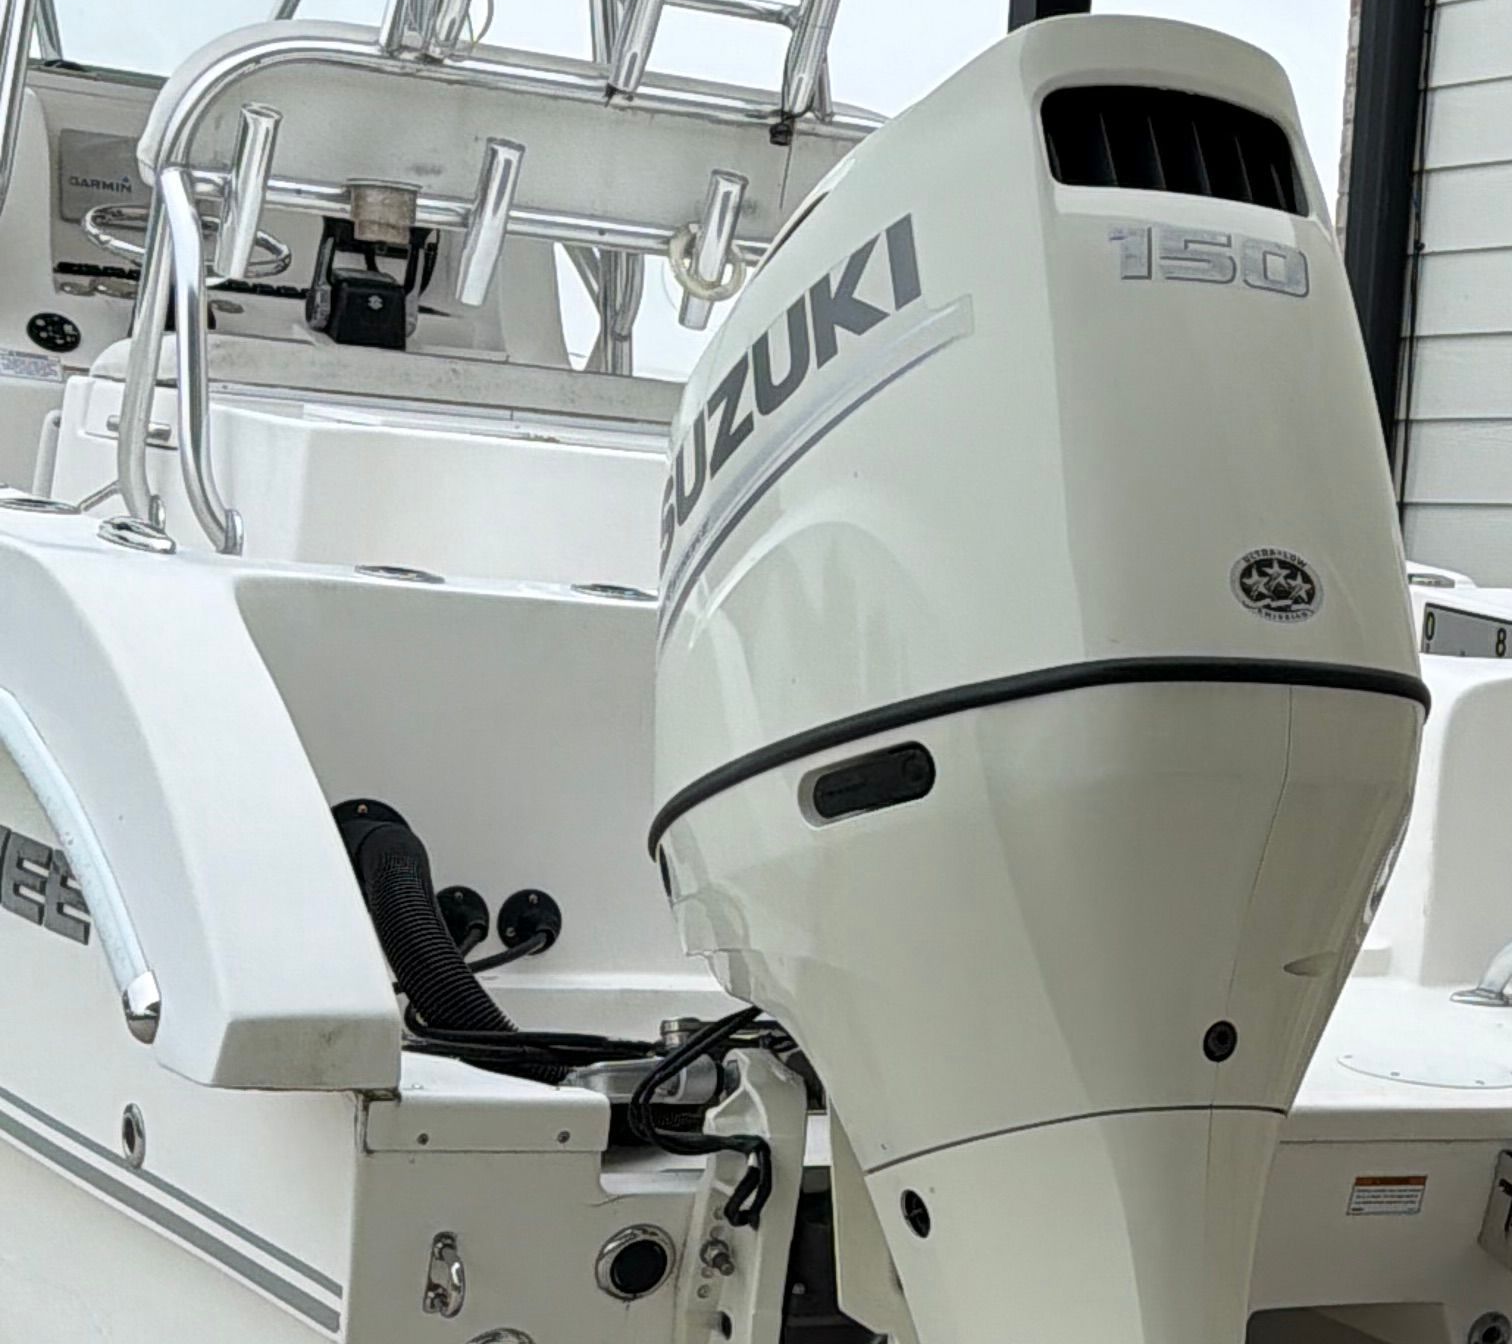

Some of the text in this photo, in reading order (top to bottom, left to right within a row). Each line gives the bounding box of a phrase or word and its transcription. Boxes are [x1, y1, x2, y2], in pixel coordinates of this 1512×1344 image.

[68, 176, 132, 194] GARMIN
[1109, 225, 1310, 298] 150
[659, 213, 922, 579] SUZUKI
[1425, 611, 1436, 642] 0
[1495, 627, 1508, 658] 8
